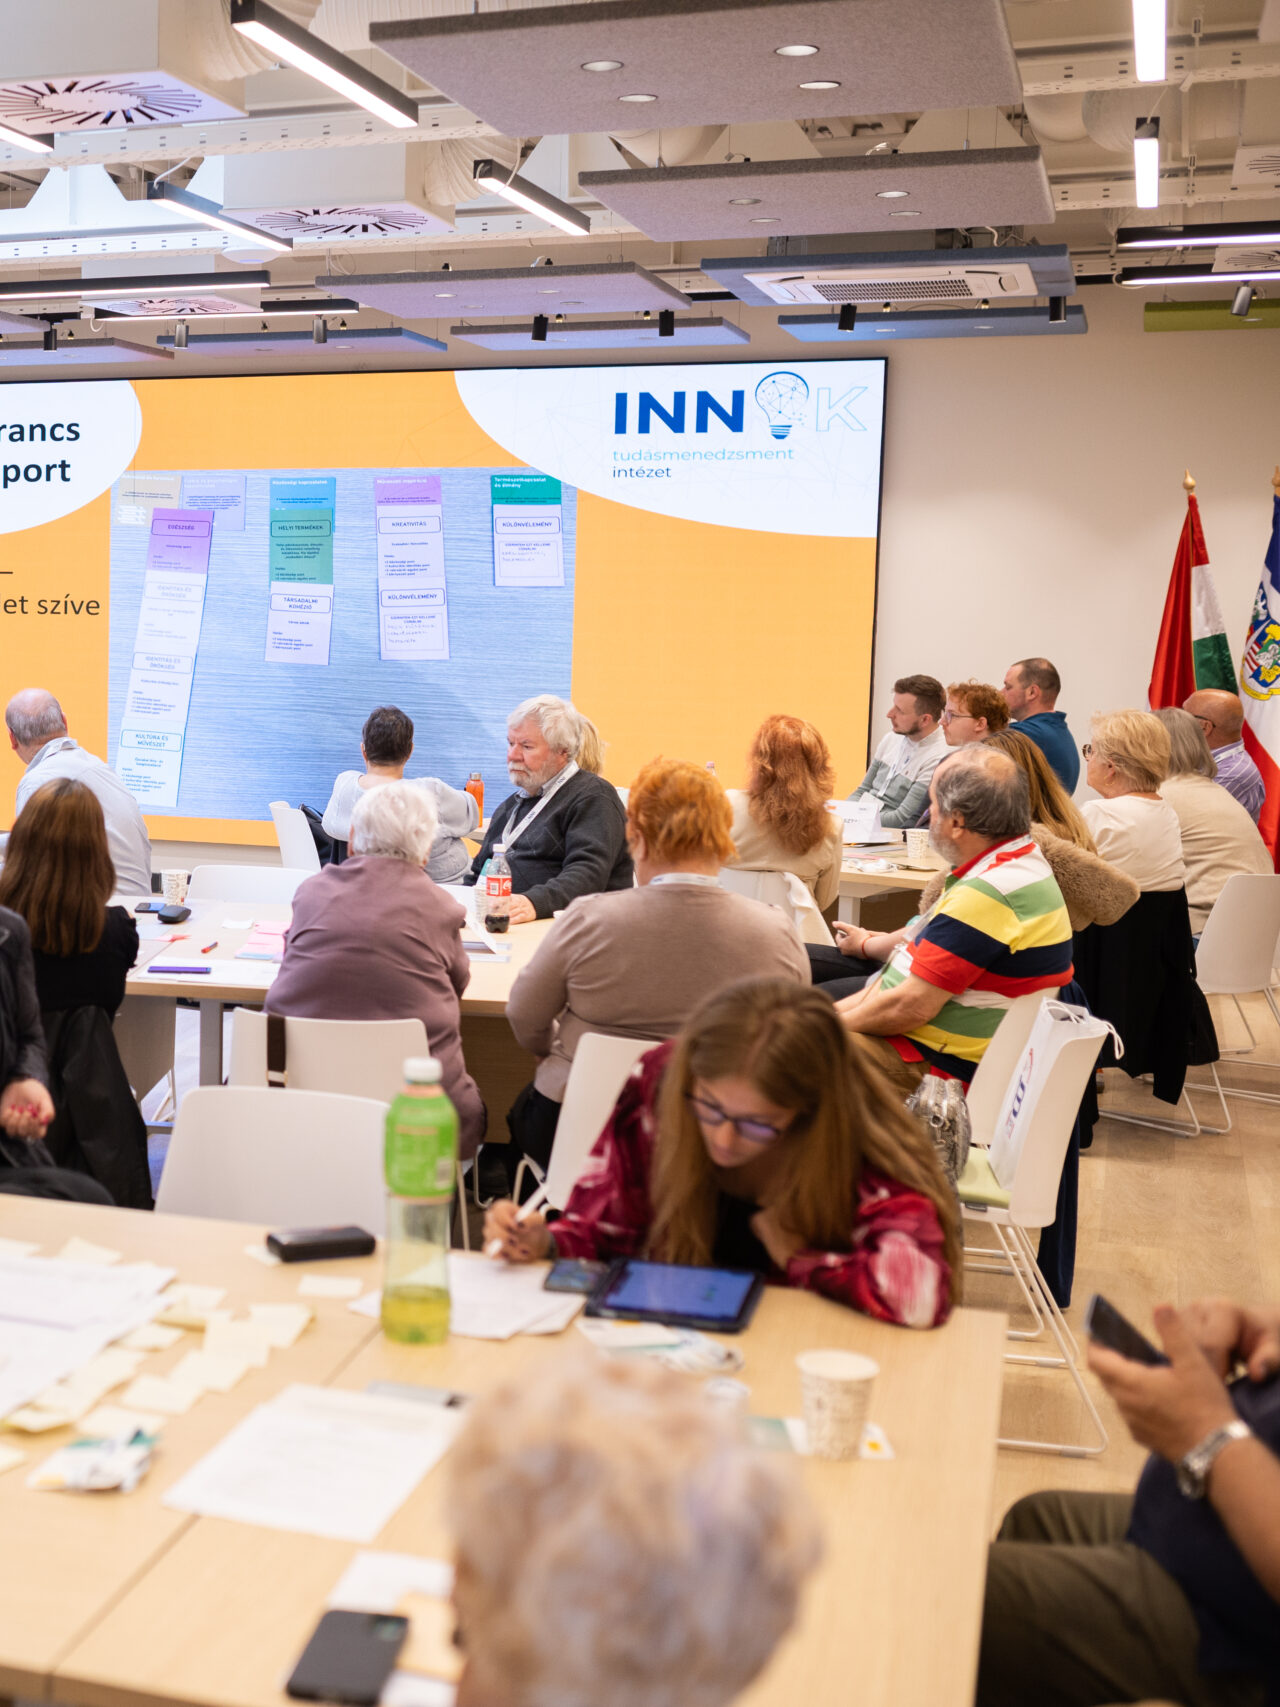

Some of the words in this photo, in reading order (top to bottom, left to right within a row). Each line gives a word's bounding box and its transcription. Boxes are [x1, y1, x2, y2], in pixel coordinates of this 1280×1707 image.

[613, 447, 794, 462] tudásmenedzsment
[612, 465, 672, 479] intézet
[38, 594, 100, 615] szíve
